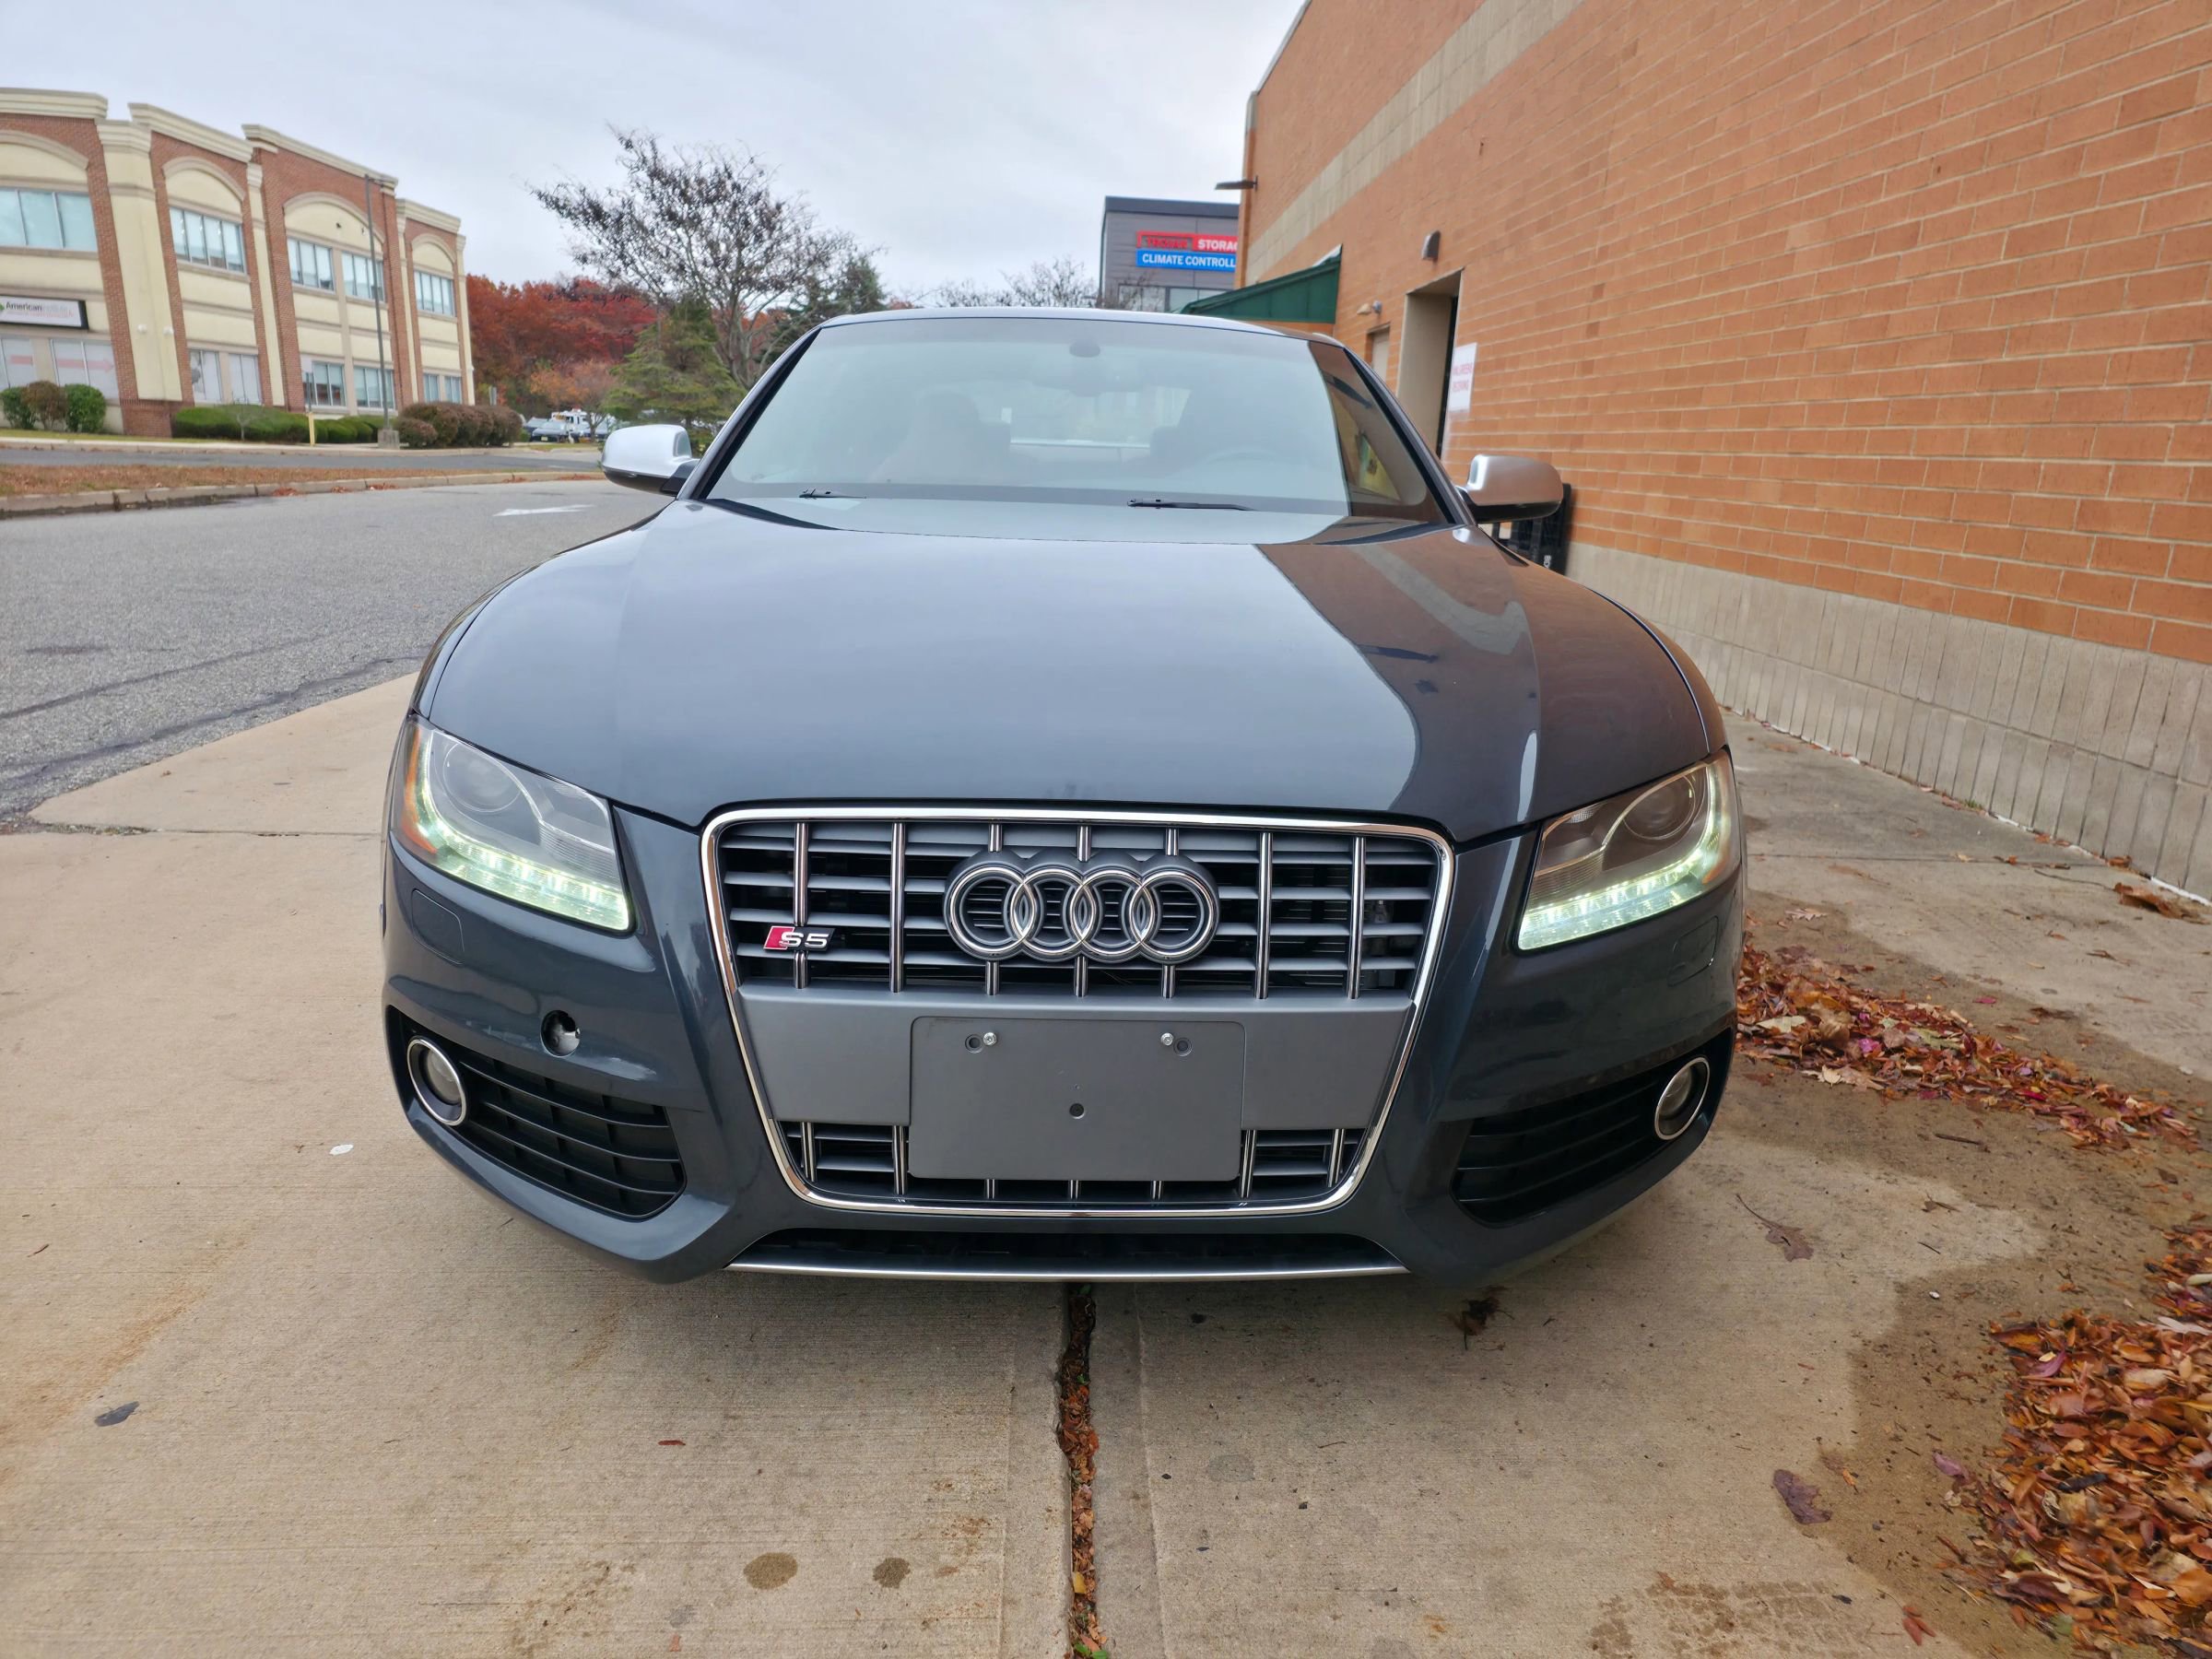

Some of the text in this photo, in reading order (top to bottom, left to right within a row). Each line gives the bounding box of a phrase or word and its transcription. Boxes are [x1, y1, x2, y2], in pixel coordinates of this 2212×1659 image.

[1142, 253, 1236, 268] CLIMATE CONTROLL
[778, 931, 830, 948] S5
